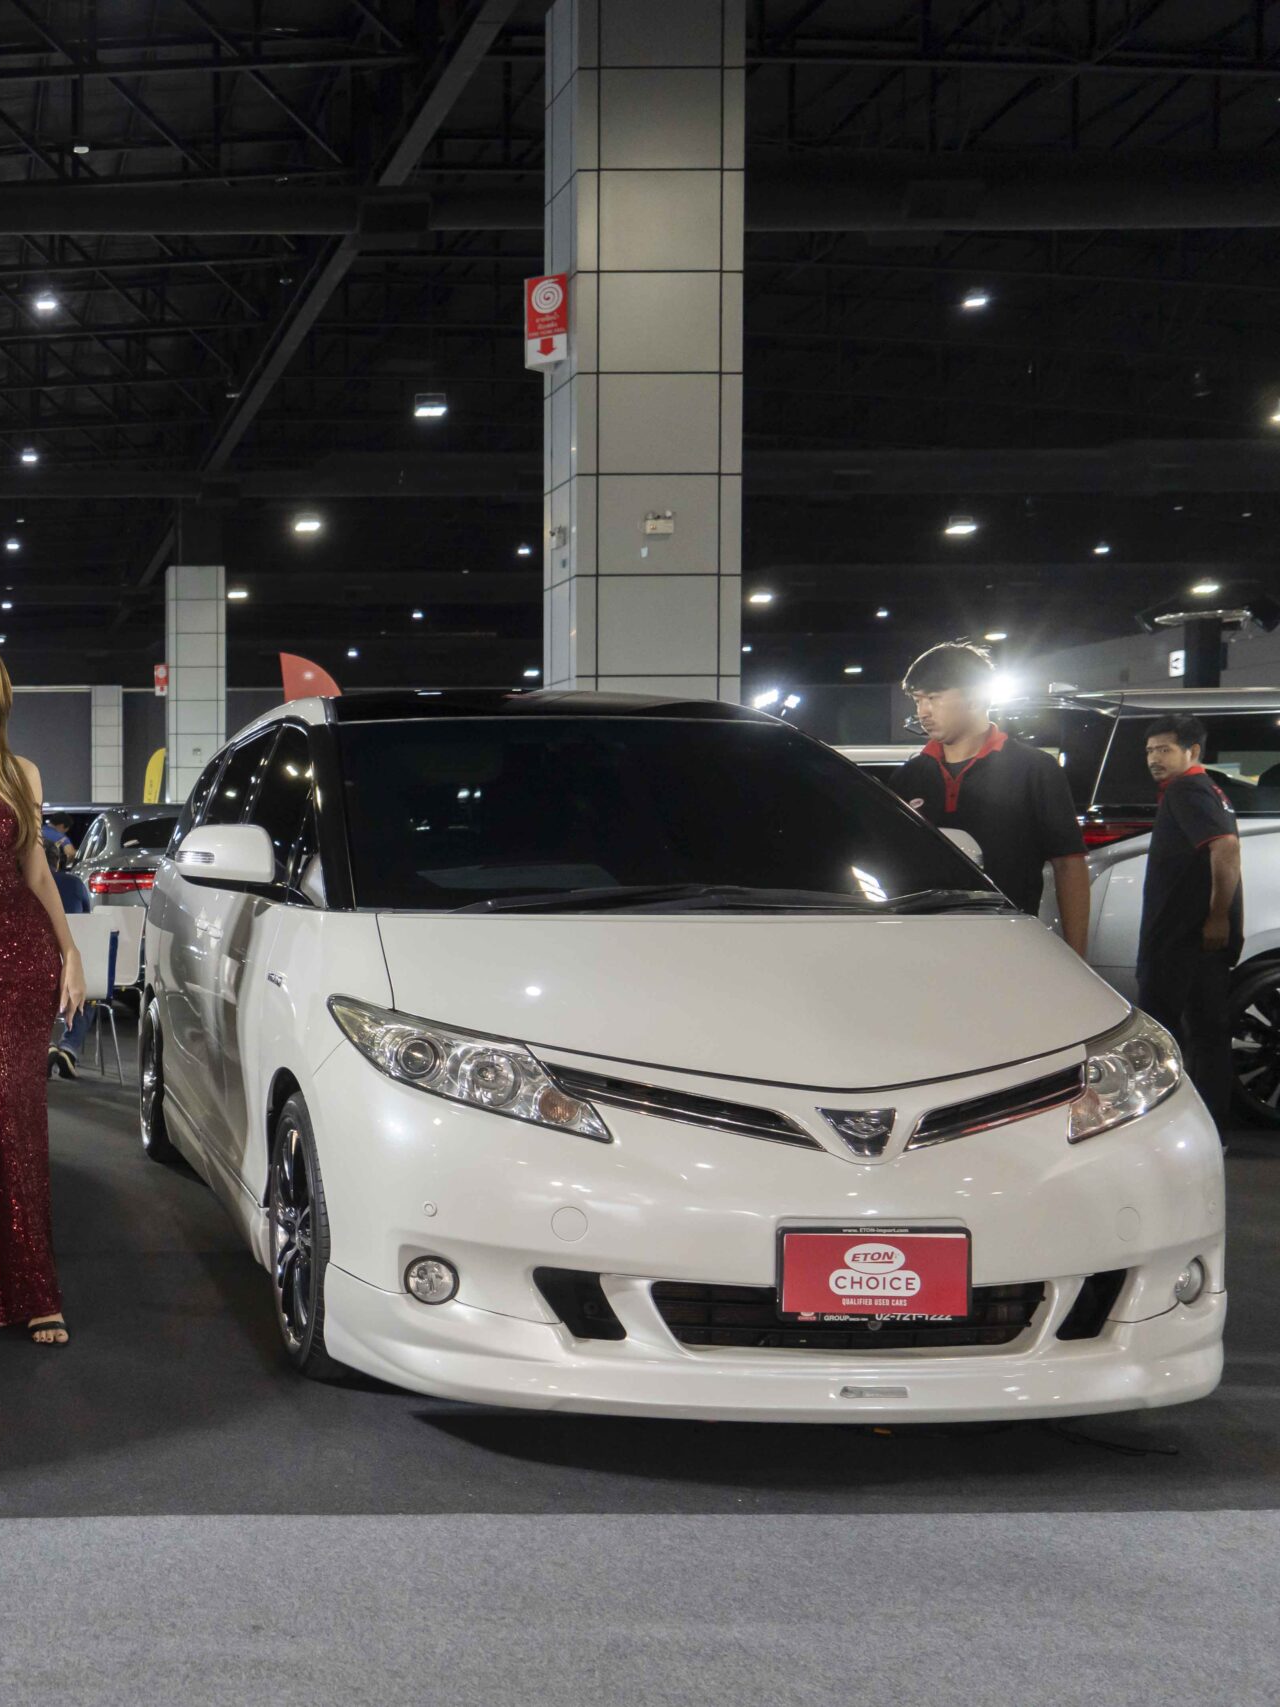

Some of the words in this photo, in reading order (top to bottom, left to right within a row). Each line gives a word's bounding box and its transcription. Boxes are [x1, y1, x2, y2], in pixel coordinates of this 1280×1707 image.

[851, 1251, 895, 1262] ETON
[834, 1275, 916, 1291] CHOICE
[841, 1297, 873, 1306] QUALIFIED
[874, 1298, 890, 1306] USED
[891, 1299, 908, 1307] CARS
